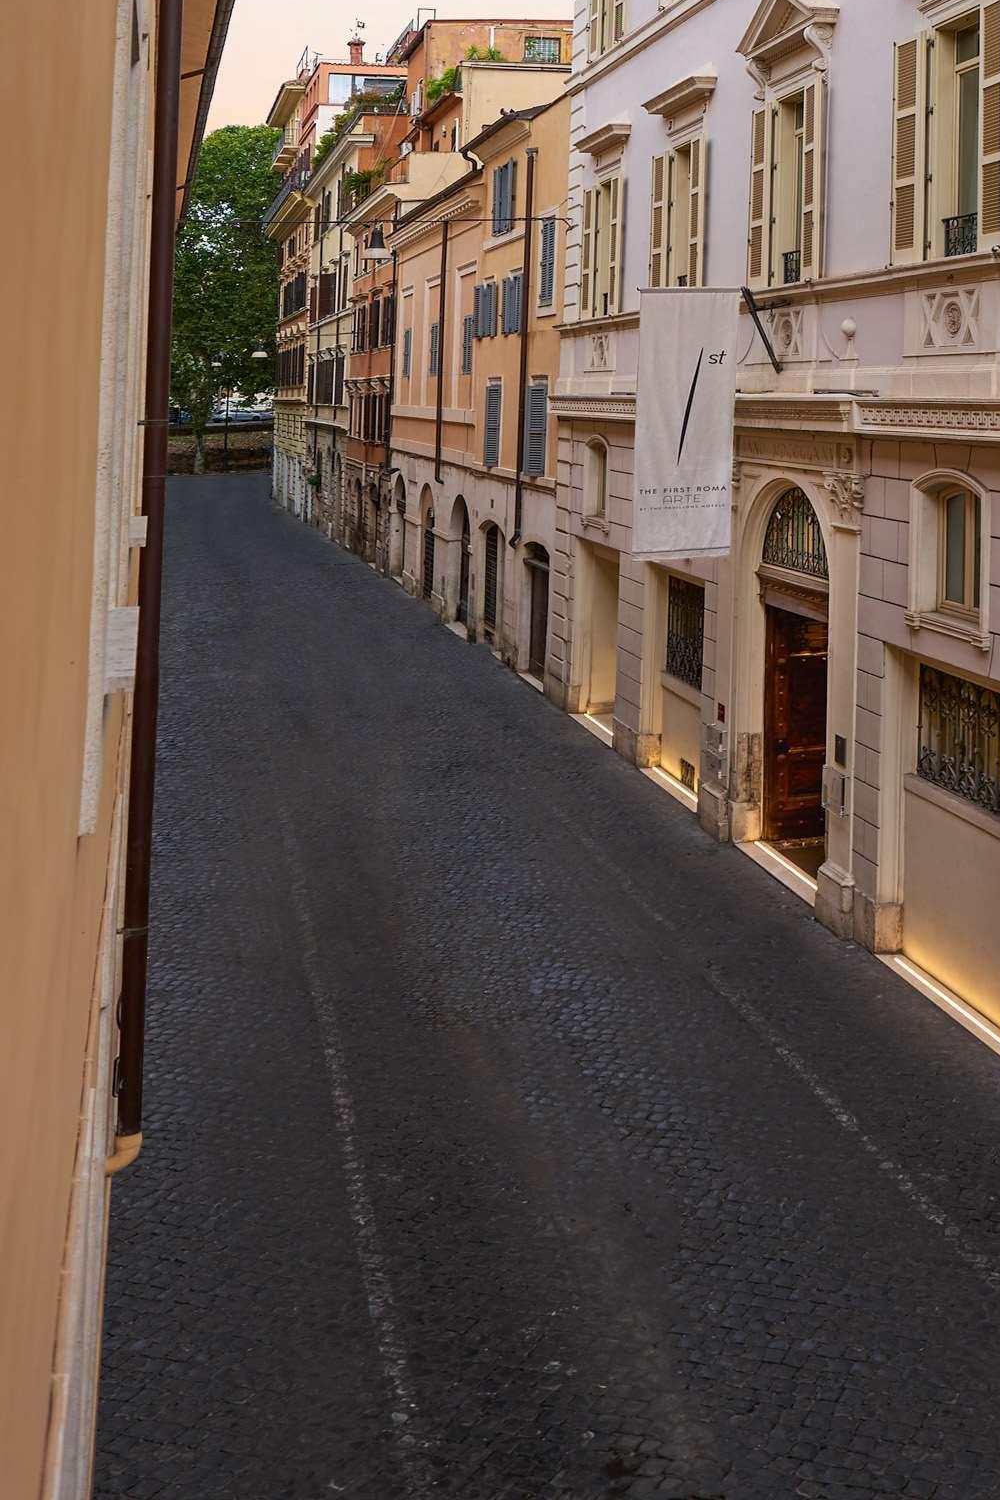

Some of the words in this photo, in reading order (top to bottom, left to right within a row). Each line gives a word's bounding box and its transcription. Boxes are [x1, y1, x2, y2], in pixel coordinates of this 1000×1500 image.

[639, 488, 657, 496] THE
[663, 486, 692, 494] FIRST
[662, 493, 704, 505] ARTE
